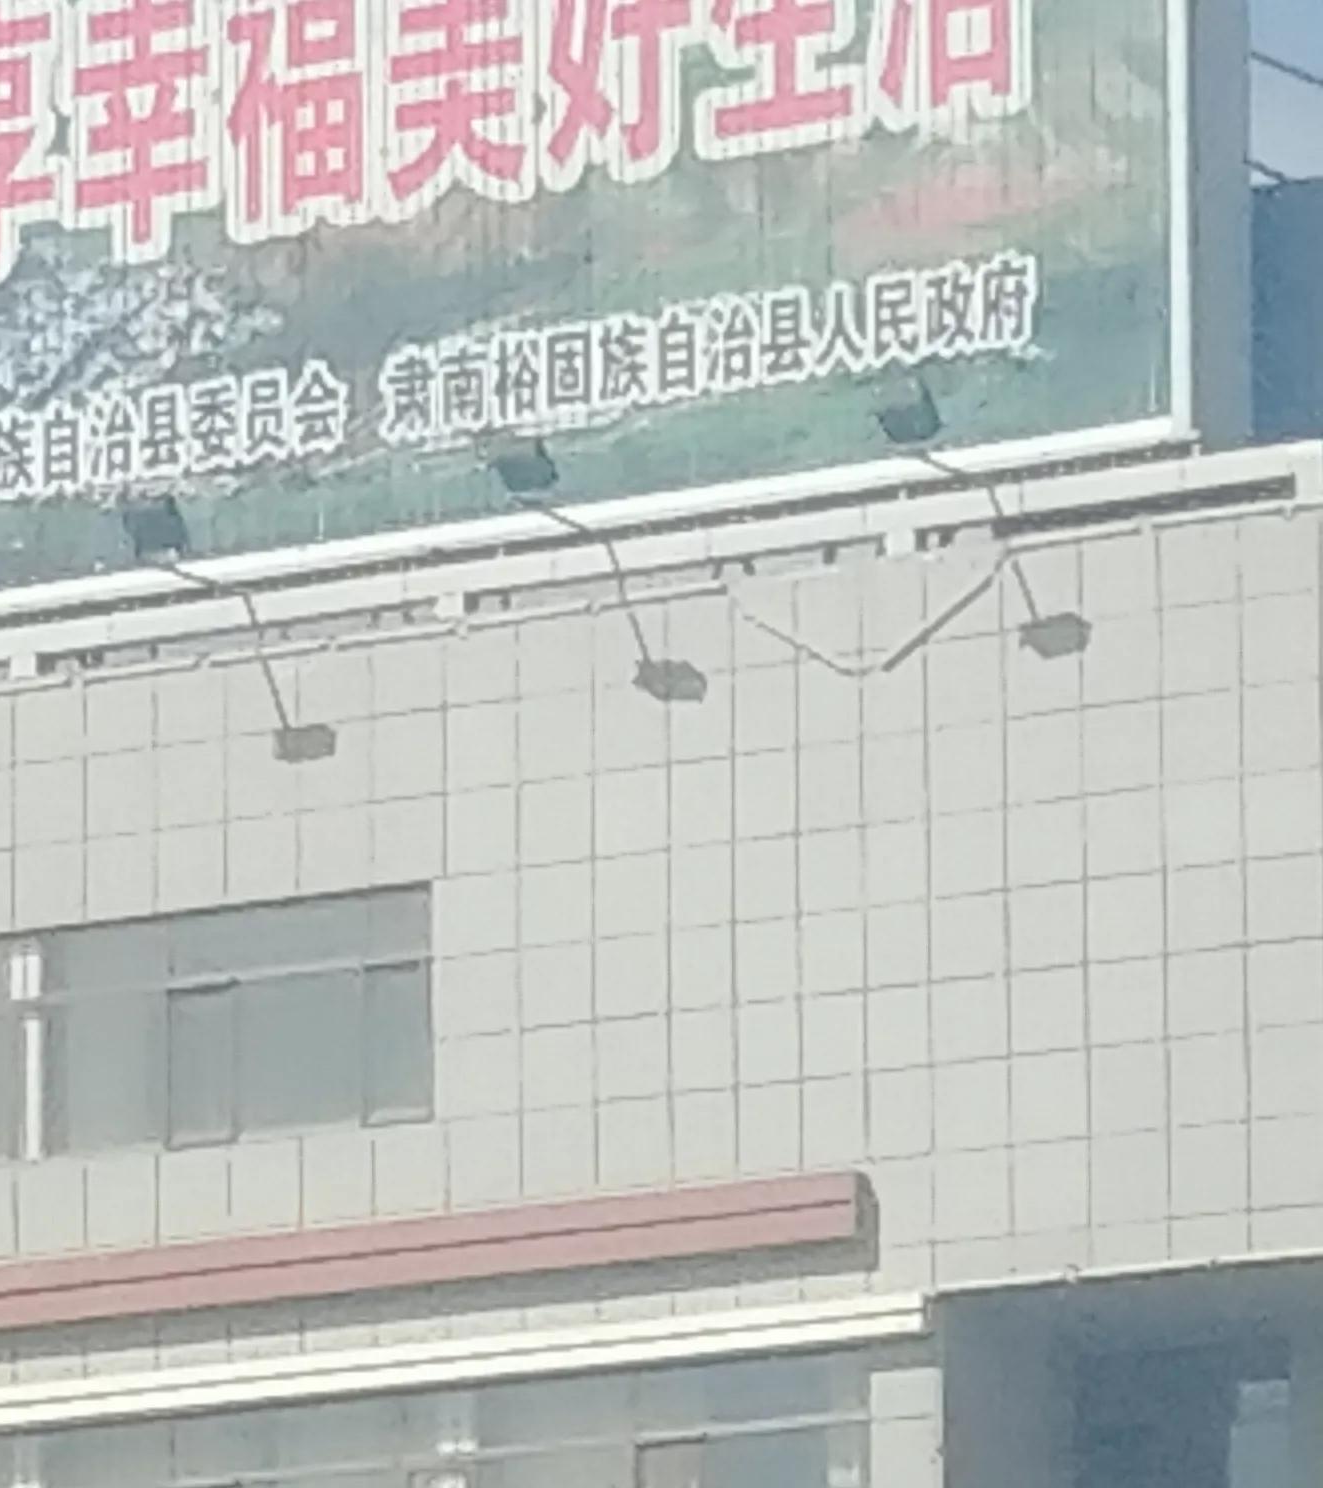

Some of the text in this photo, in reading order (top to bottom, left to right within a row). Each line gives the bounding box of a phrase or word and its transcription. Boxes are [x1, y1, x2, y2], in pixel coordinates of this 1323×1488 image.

[385, 258, 1031, 432] 肃南裕固族自治县人民政府
